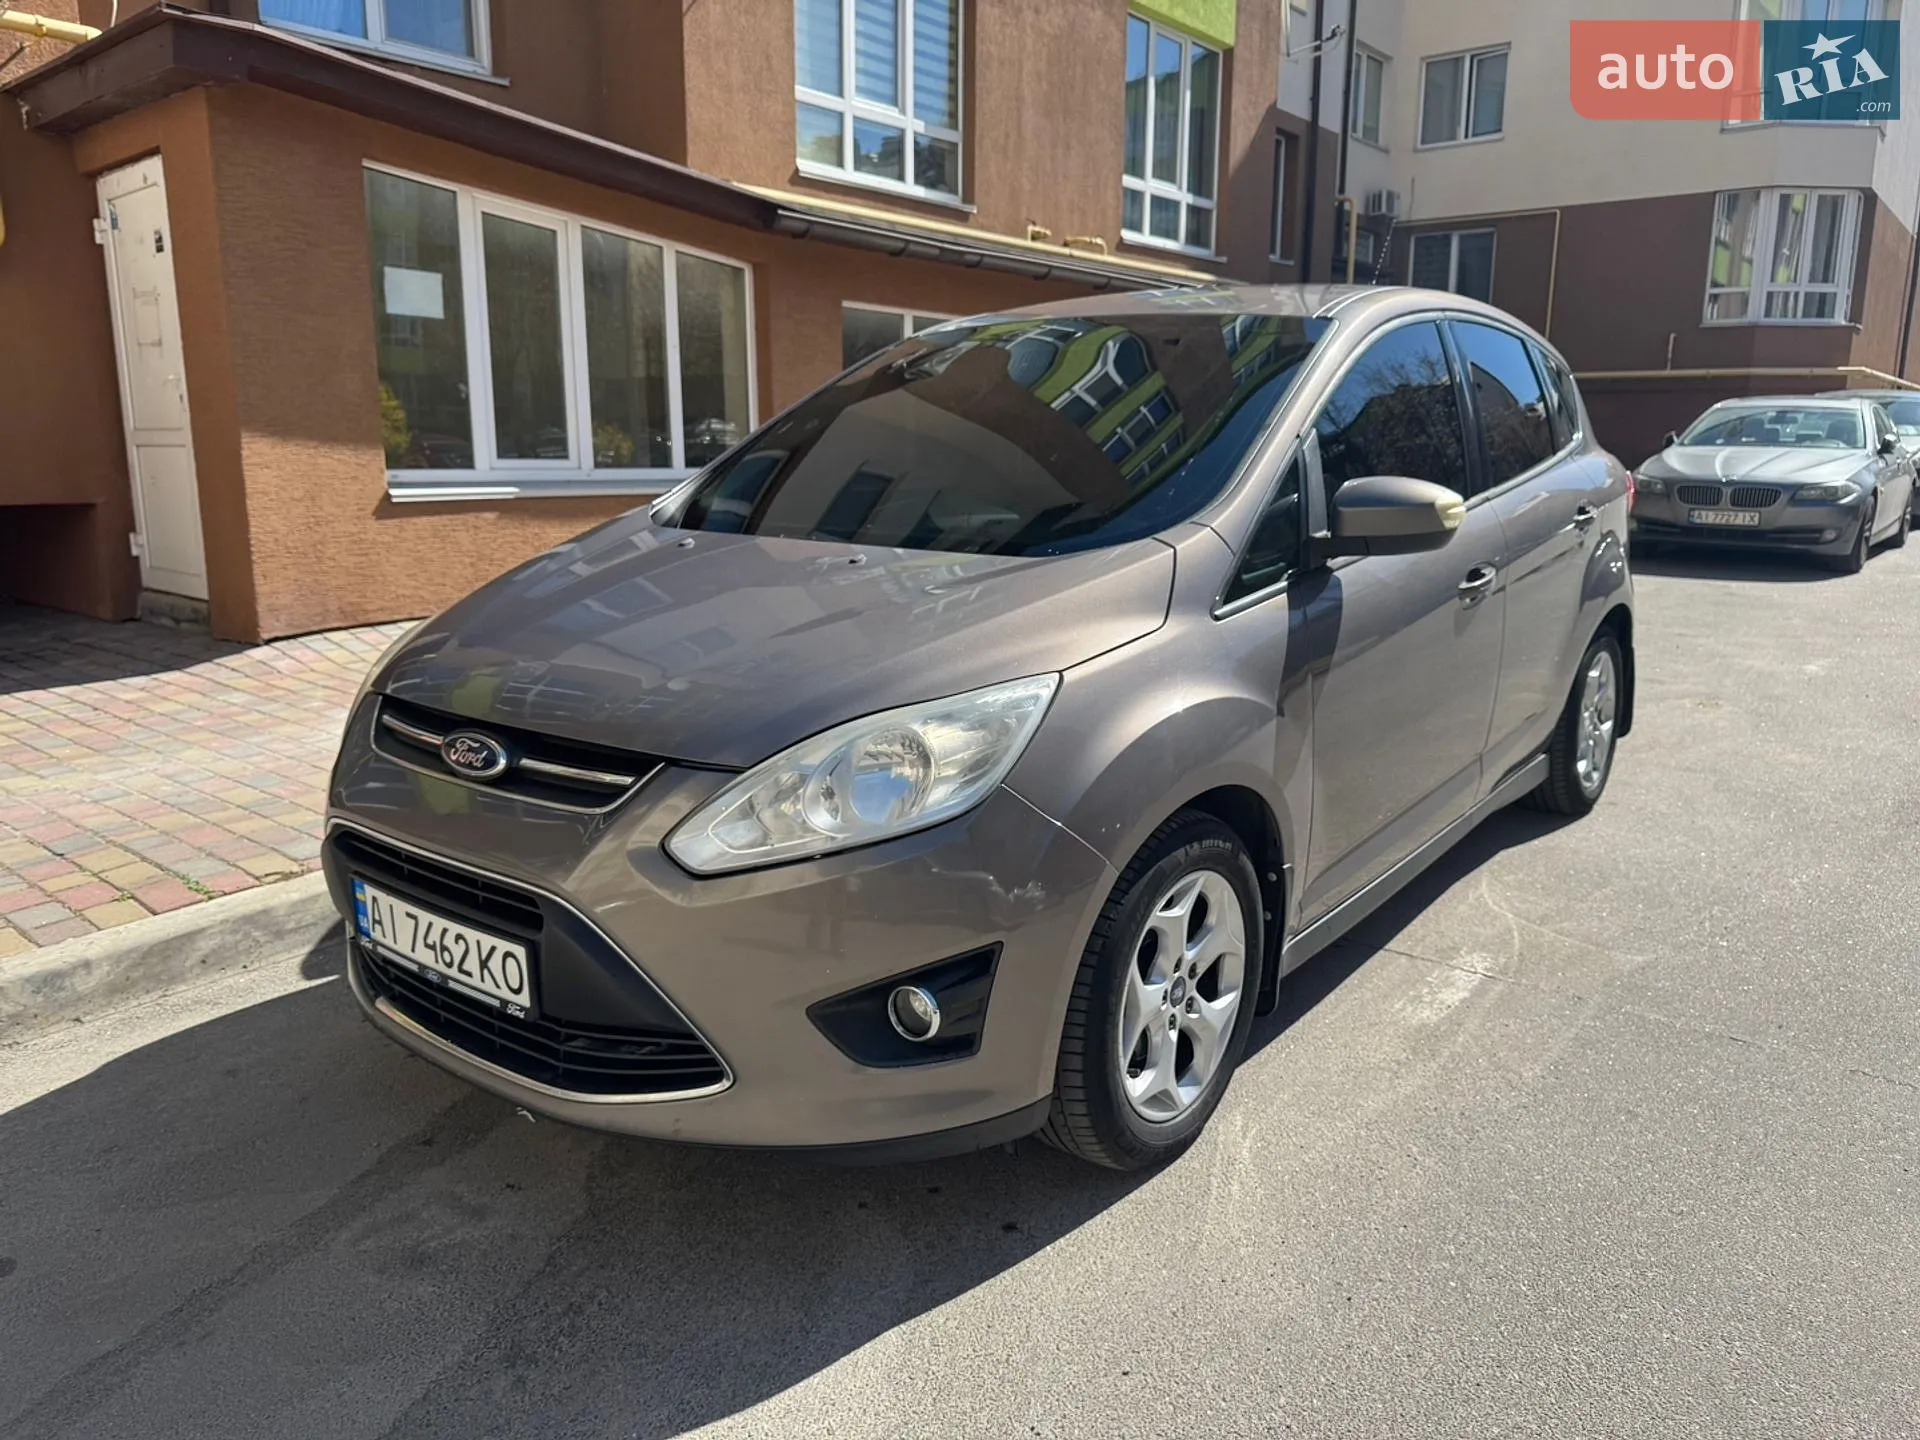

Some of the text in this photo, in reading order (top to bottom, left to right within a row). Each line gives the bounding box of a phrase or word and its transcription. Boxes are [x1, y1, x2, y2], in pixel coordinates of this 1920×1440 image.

[450, 738, 488, 767] Ford
[372, 896, 524, 996] AI 7462 KO
